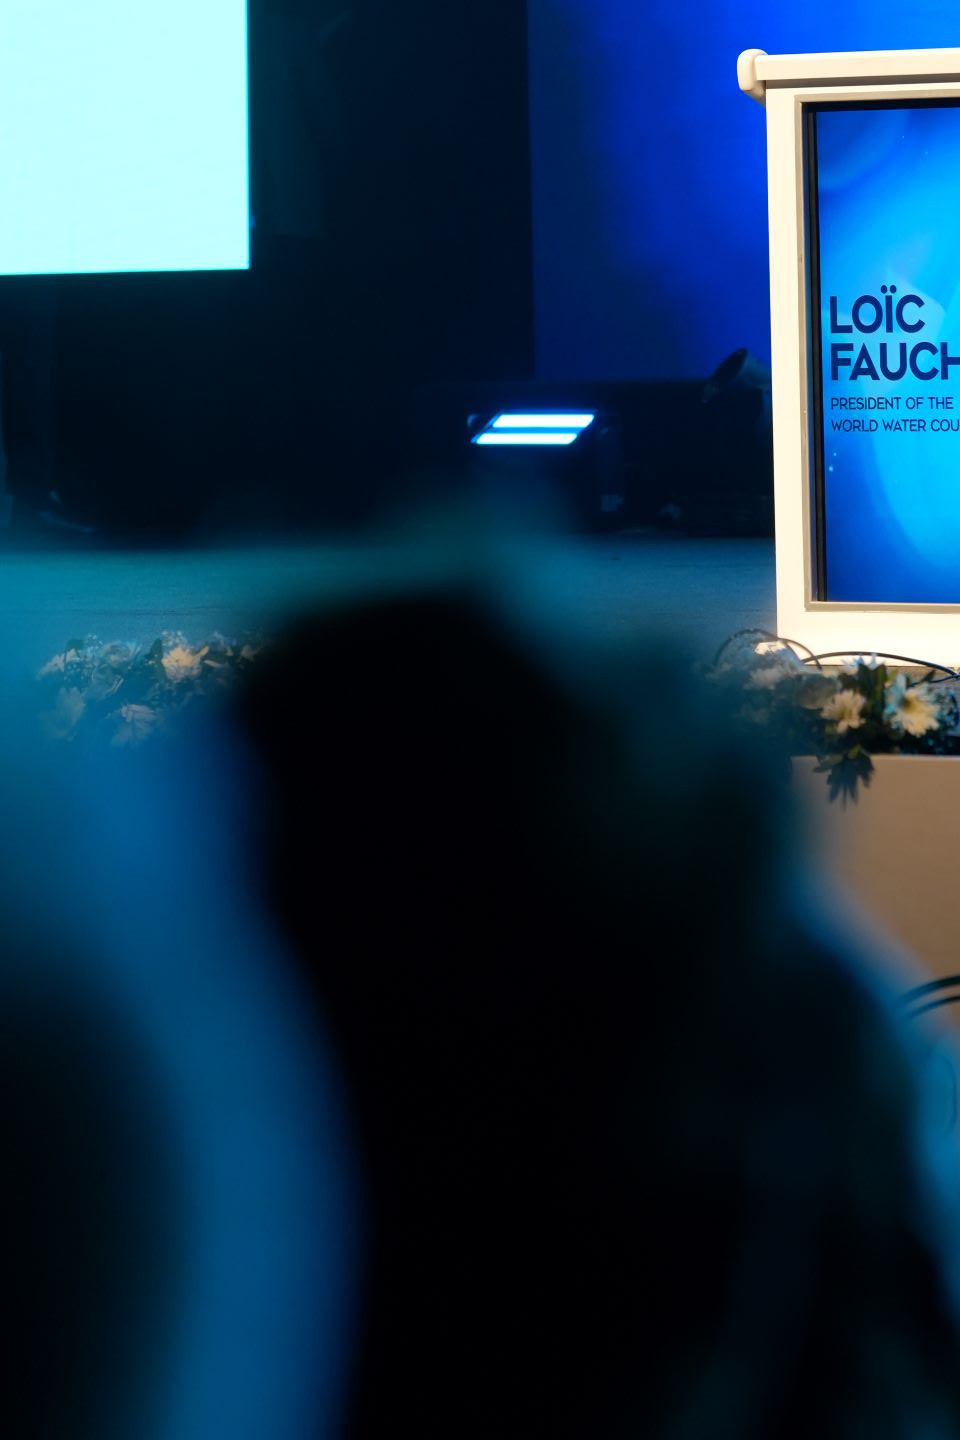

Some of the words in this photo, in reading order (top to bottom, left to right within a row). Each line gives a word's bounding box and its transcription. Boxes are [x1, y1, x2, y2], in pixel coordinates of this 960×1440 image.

[829, 284, 926, 334] LOÏC
[830, 396, 902, 411] PRESIDENT
[905, 396, 925, 410] OF
[927, 396, 954, 410] THE
[830, 419, 879, 433] WORLD
[881, 418, 927, 433] WATER
